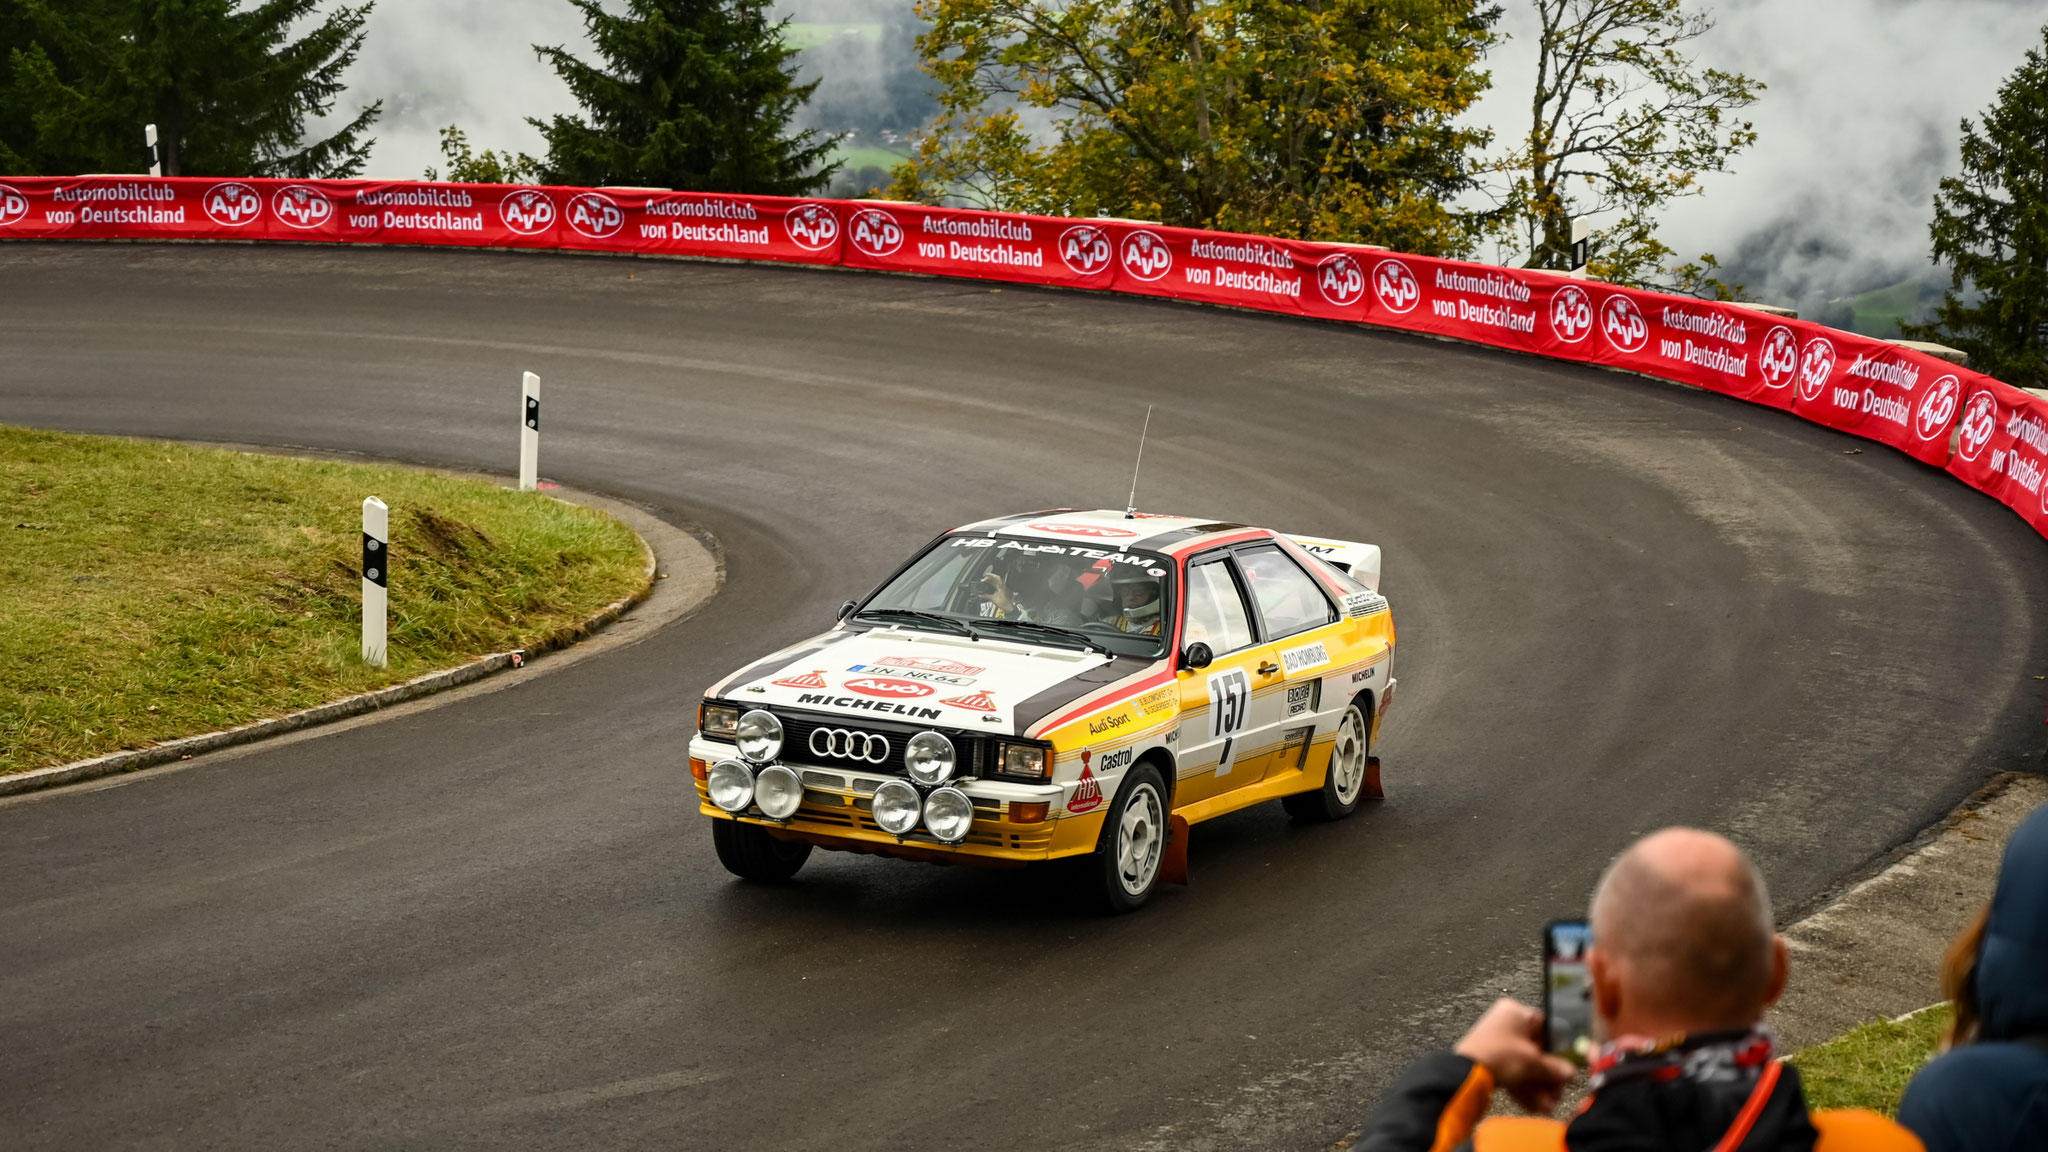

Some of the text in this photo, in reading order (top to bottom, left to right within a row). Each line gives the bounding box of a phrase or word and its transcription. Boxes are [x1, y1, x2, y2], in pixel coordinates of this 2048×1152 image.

[53, 183, 175, 202] Automobilclub
[355, 189, 473, 207] Automobilclub
[45, 206, 185, 224] von Deutschland
[348, 211, 483, 231] von Deutschland
[645, 199, 757, 220] Automobilclub
[640, 222, 769, 245] von Deutschland
[923, 215, 1032, 241] Automobilclub
[918, 240, 1043, 267] von Deutschland
[1191, 239, 1294, 269] Automobilclub
[1186, 266, 1301, 297] von Deutschland
[1436, 268, 1531, 303] Automobilclub
[1432, 298, 1536, 333] von Deutschland
[1662, 306, 1747, 344] Automobilclub
[1661, 338, 1748, 377] von Deutschland
[1833, 387, 1859, 410] von
[951, 538, 997, 548] HB
[1069, 546, 1156, 568] TEAM
[1283, 652, 1298, 670] BAD
[904, 671, 932, 679] NR
[934, 675, 960, 683] 64
[1351, 666, 1375, 684] MICHELIN
[851, 679, 929, 697] Audi
[797, 694, 942, 719] MICHELIN
[1210, 671, 1247, 736] 157
[1089, 713, 1131, 736] Audi Sport
[1100, 746, 1133, 772] Castrol
[1077, 777, 1097, 801] HB
